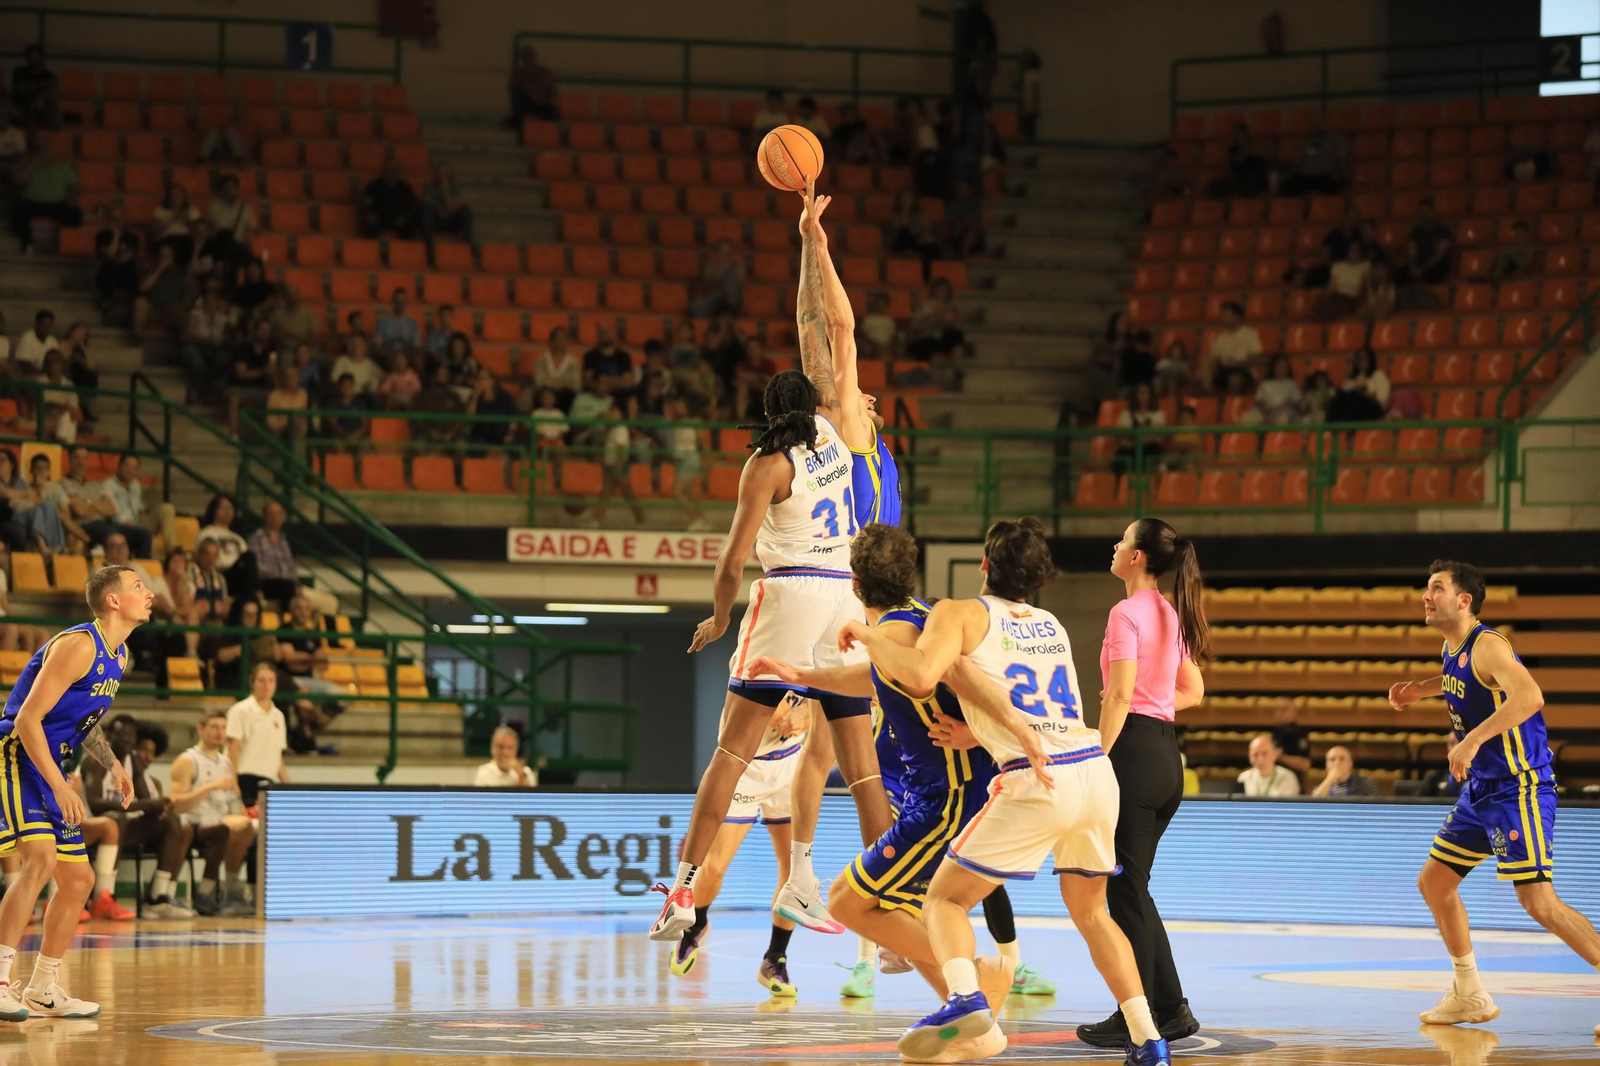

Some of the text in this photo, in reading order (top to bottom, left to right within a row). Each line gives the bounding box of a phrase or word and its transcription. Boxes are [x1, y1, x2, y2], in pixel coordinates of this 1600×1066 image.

[302, 30, 318, 65] 1
[1551, 43, 1571, 74] 2
[805, 442, 840, 475] BROWN
[811, 486, 856, 540] 31
[515, 533, 761, 561] SAIDA E ASE
[1004, 662, 1079, 720] 24
[389, 815, 687, 896] La Regi
